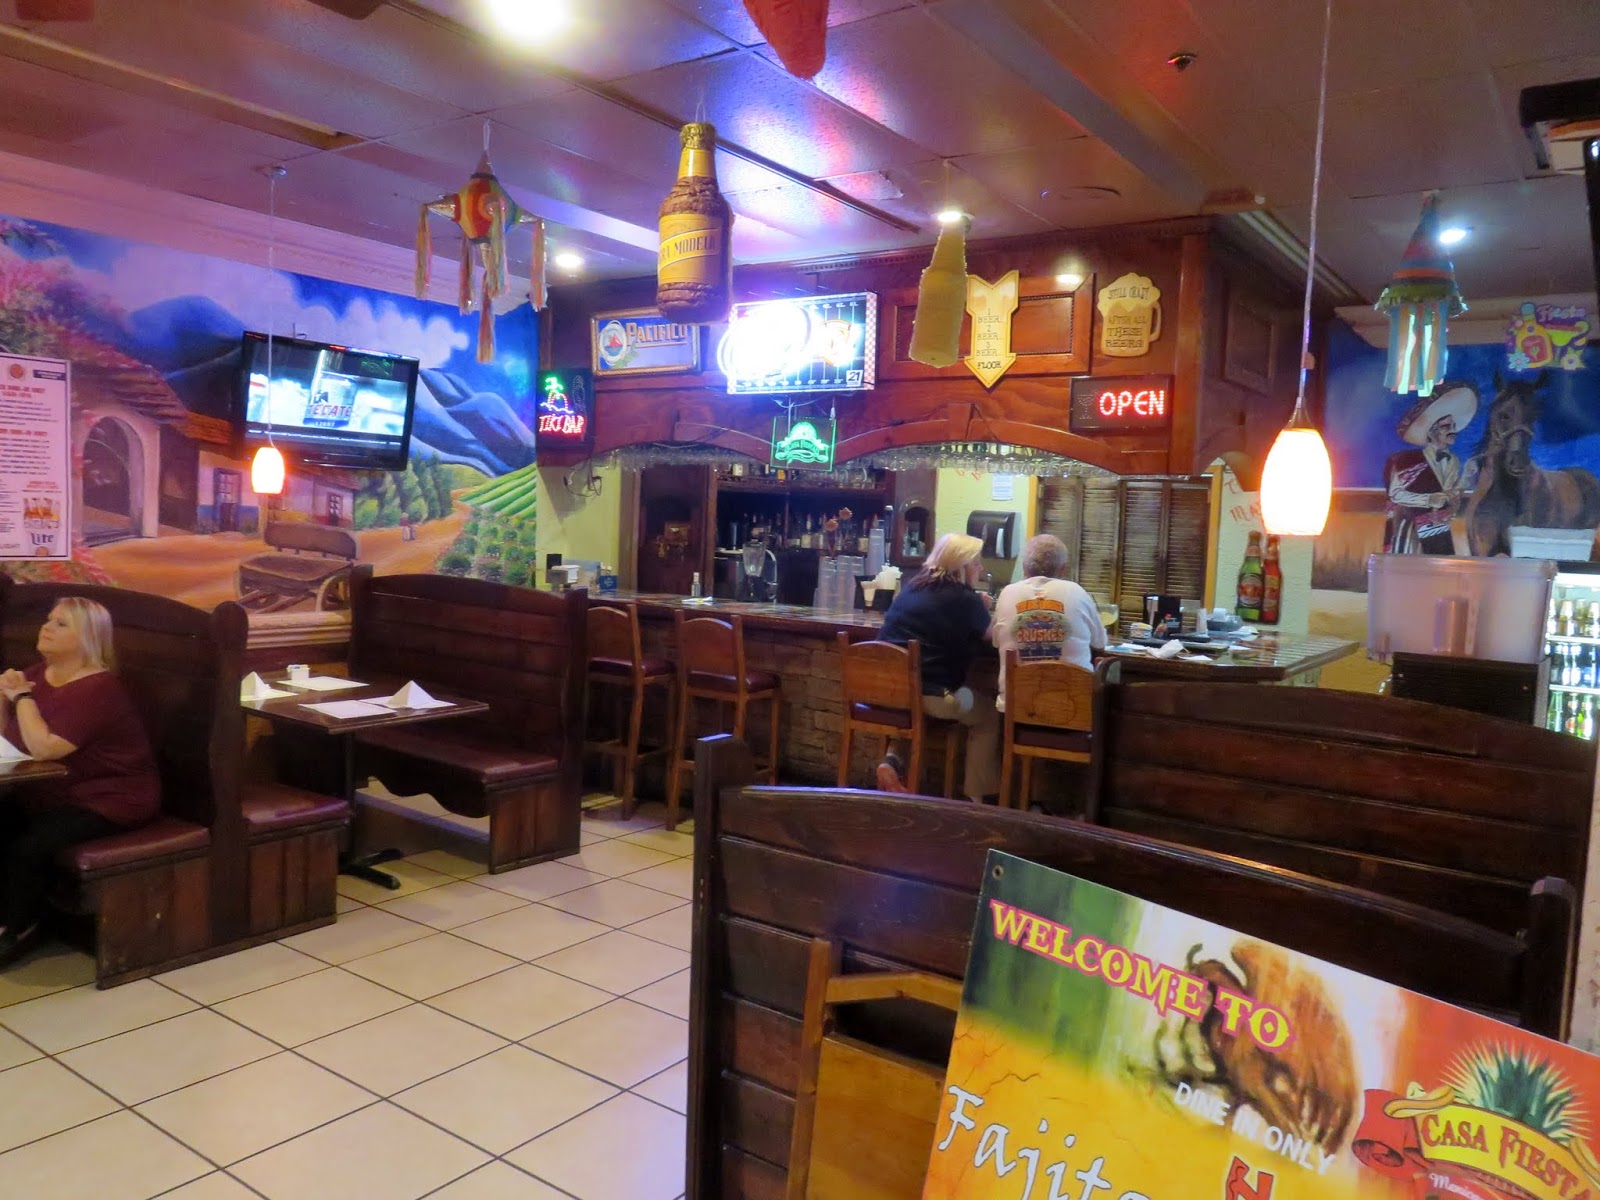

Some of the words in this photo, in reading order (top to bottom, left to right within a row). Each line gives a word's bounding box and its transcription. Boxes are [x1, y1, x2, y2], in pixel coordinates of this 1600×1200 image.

[626, 322, 688, 346] PACIFICO
[1106, 326, 1142, 338] THESE
[1105, 339, 1142, 348] BEERS
[977, 361, 1002, 369] FLOOR
[848, 371, 861, 382] 21
[309, 403, 353, 418] TECATE
[1099, 390, 1165, 416] OPEN
[538, 414, 562, 432] TIKI
[561, 414, 585, 434] BAR
[989, 898, 1210, 1022] WELCOME
[1215, 984, 1296, 1053] TO
[1174, 1081, 1231, 1126] DINE
[1232, 1105, 1262, 1141] IN
[1263, 1125, 1337, 1176] ONLY
[1420, 1113, 1490, 1154] CASA
[937, 1084, 1152, 1200] Fajit
